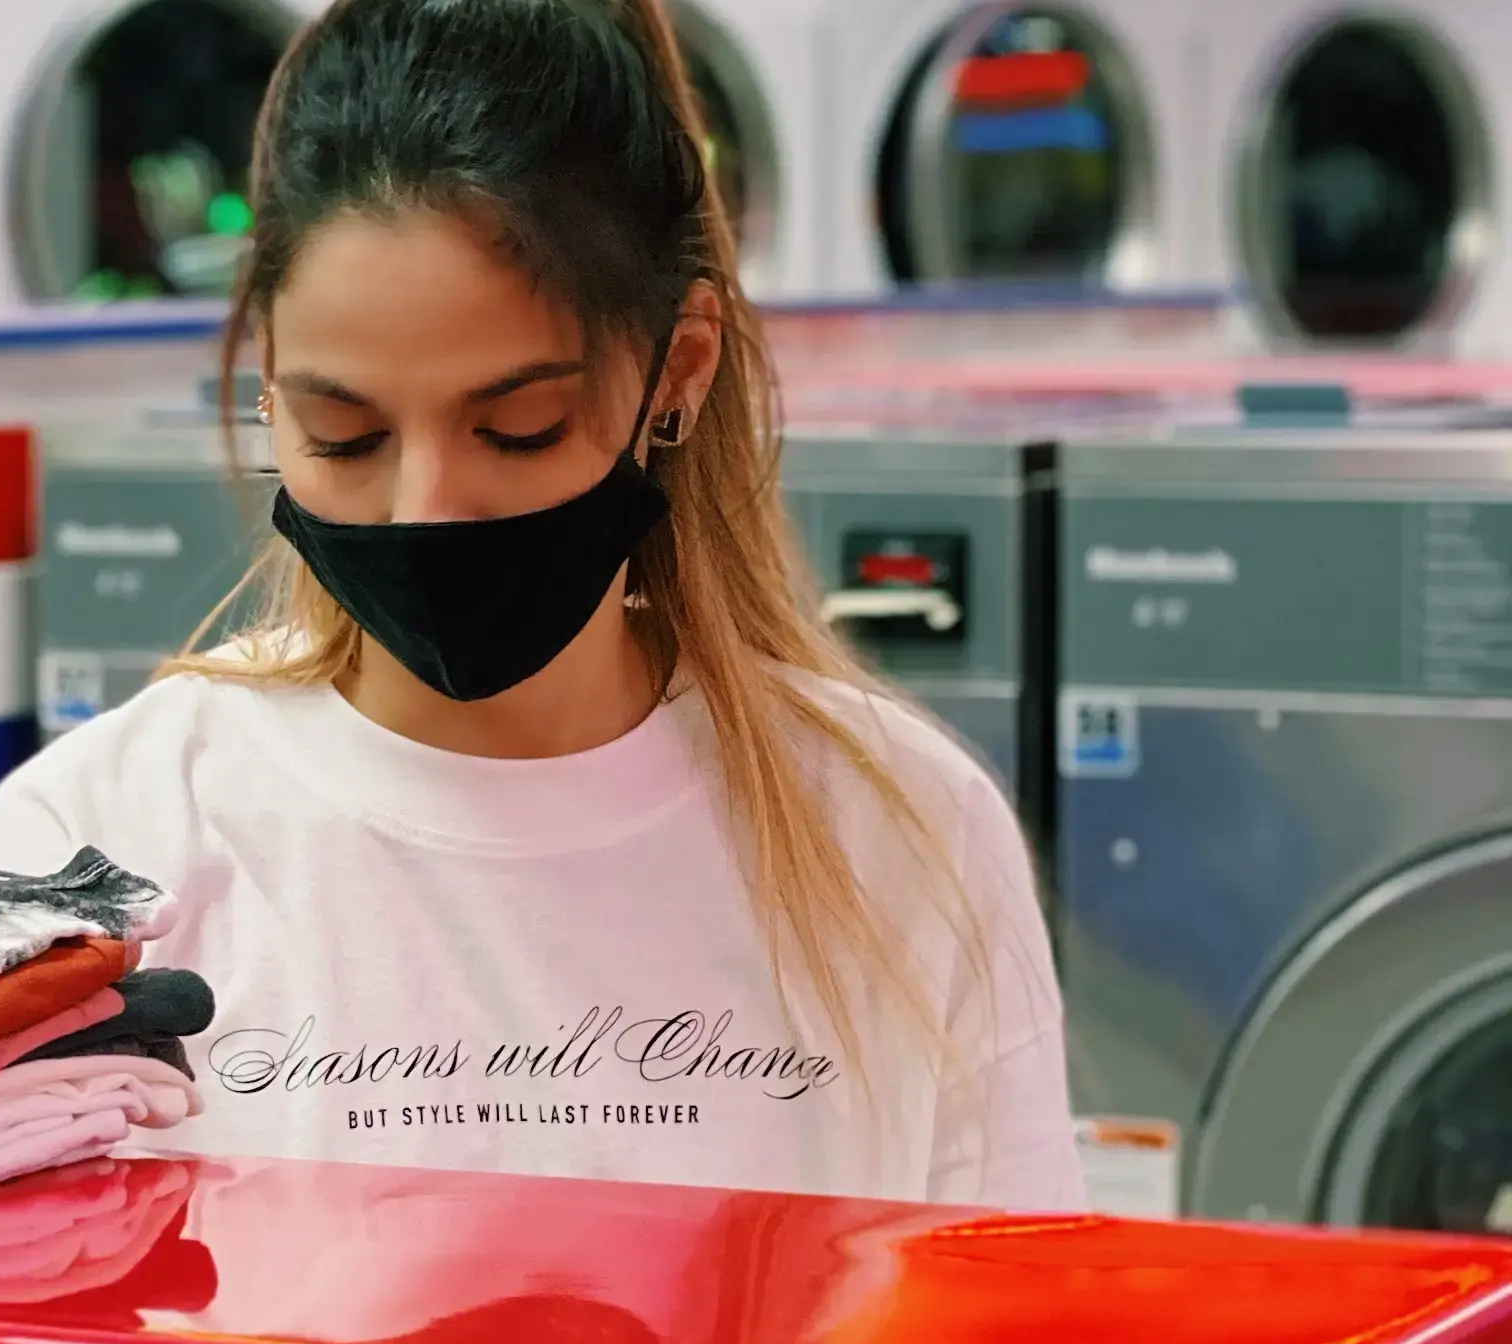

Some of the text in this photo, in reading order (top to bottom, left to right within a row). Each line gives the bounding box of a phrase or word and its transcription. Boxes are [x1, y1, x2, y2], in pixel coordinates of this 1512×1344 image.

[208, 1014, 471, 1094] Seasons
[484, 1005, 624, 1078] will
[348, 1103, 699, 1130] BUT STYLE WILL LAST FOREVER
